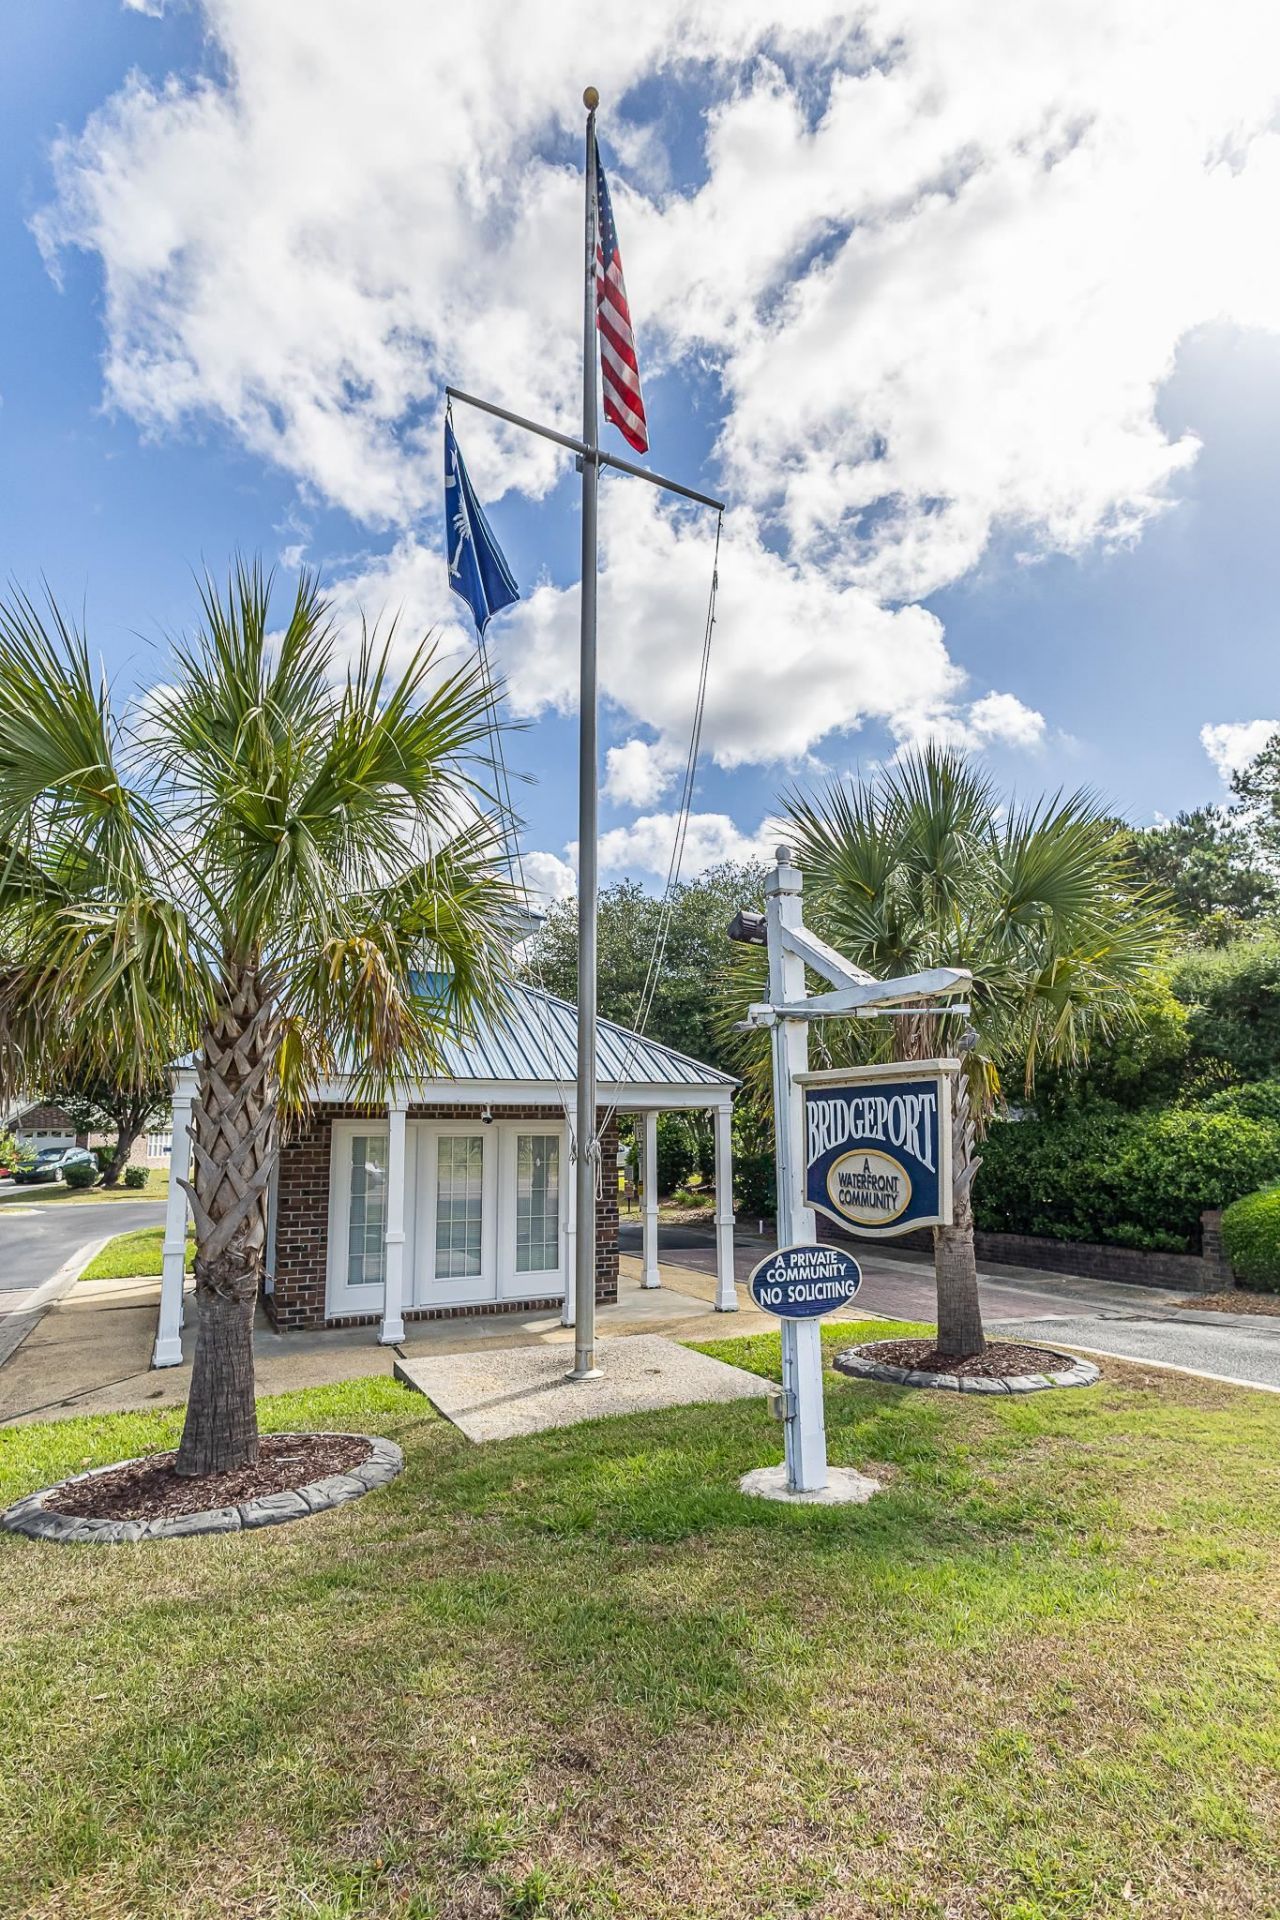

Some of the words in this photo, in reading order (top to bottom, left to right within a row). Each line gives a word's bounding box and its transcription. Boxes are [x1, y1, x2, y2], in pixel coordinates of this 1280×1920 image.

[806, 1093, 937, 1174] BRIDGEPORT
[862, 1157, 871, 1173] A
[838, 1172, 899, 1193] WATERFRONT
[838, 1189, 898, 1210] COMMUNITY
[774, 1255, 785, 1269] A
[790, 1251, 837, 1267] PRIVATE
[766, 1263, 847, 1283] COMMUNITY
[760, 1287, 782, 1306] NO
[787, 1280, 855, 1303] SOLICITING
